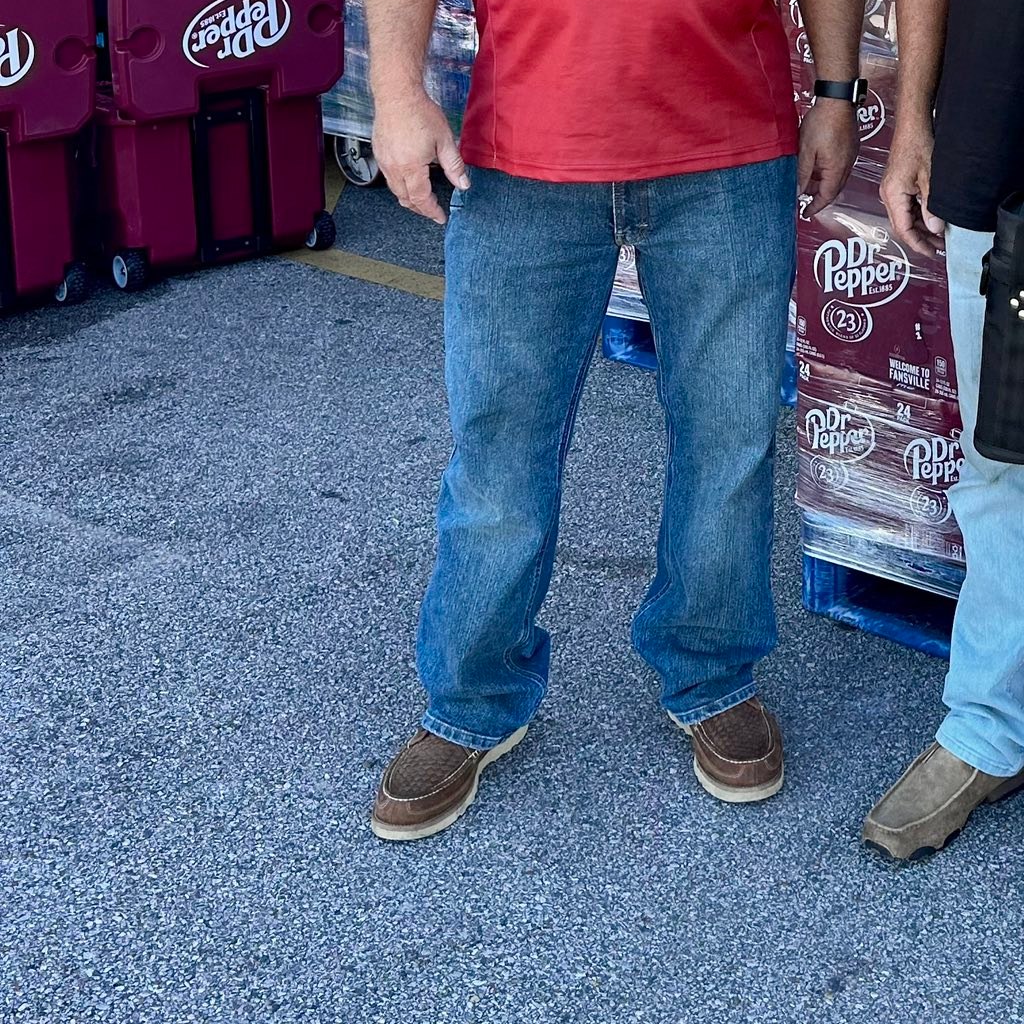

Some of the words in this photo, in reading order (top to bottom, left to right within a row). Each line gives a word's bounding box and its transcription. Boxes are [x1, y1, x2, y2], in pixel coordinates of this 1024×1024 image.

[217, 24, 256, 59] Dr
[847, 237, 880, 269] Dr
[814, 239, 903, 298] Pepper
[836, 309, 856, 332] 23
[799, 360, 811, 377] 24
[889, 358, 920, 375] WELCOME
[921, 368, 930, 378] TO
[889, 368, 930, 390] FANSVILLE
[826, 407, 851, 431] Dr
[896, 403, 911, 419] 24
[805, 409, 868, 454] Pepper
[931, 437, 959, 461] Dr
[818, 465, 834, 483] 23
[922, 495, 936, 512] 23
